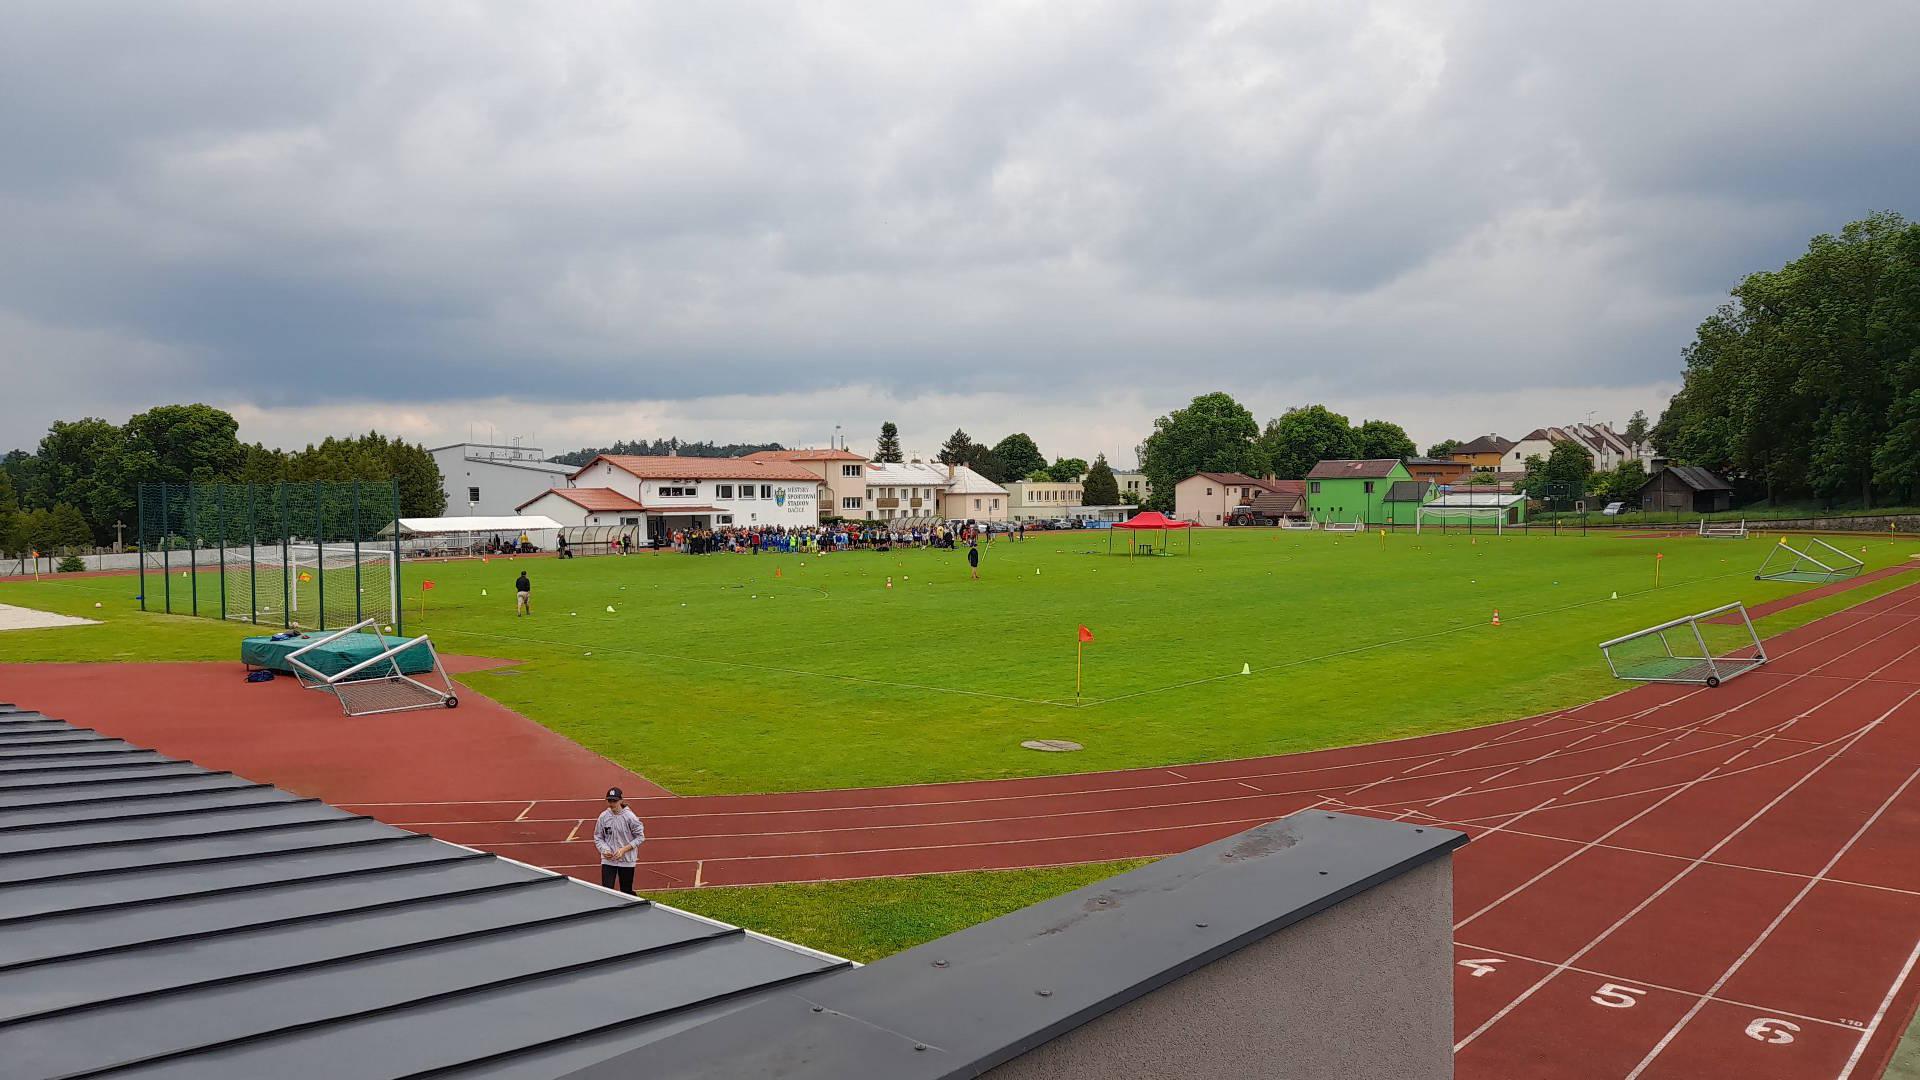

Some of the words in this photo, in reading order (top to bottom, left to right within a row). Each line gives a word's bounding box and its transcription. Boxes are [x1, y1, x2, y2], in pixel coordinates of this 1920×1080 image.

[1457, 958, 1507, 977] 4
[1590, 983, 1647, 1008] 5
[1745, 1017, 1800, 1044] 6
[1837, 1018, 1864, 1027] 110
